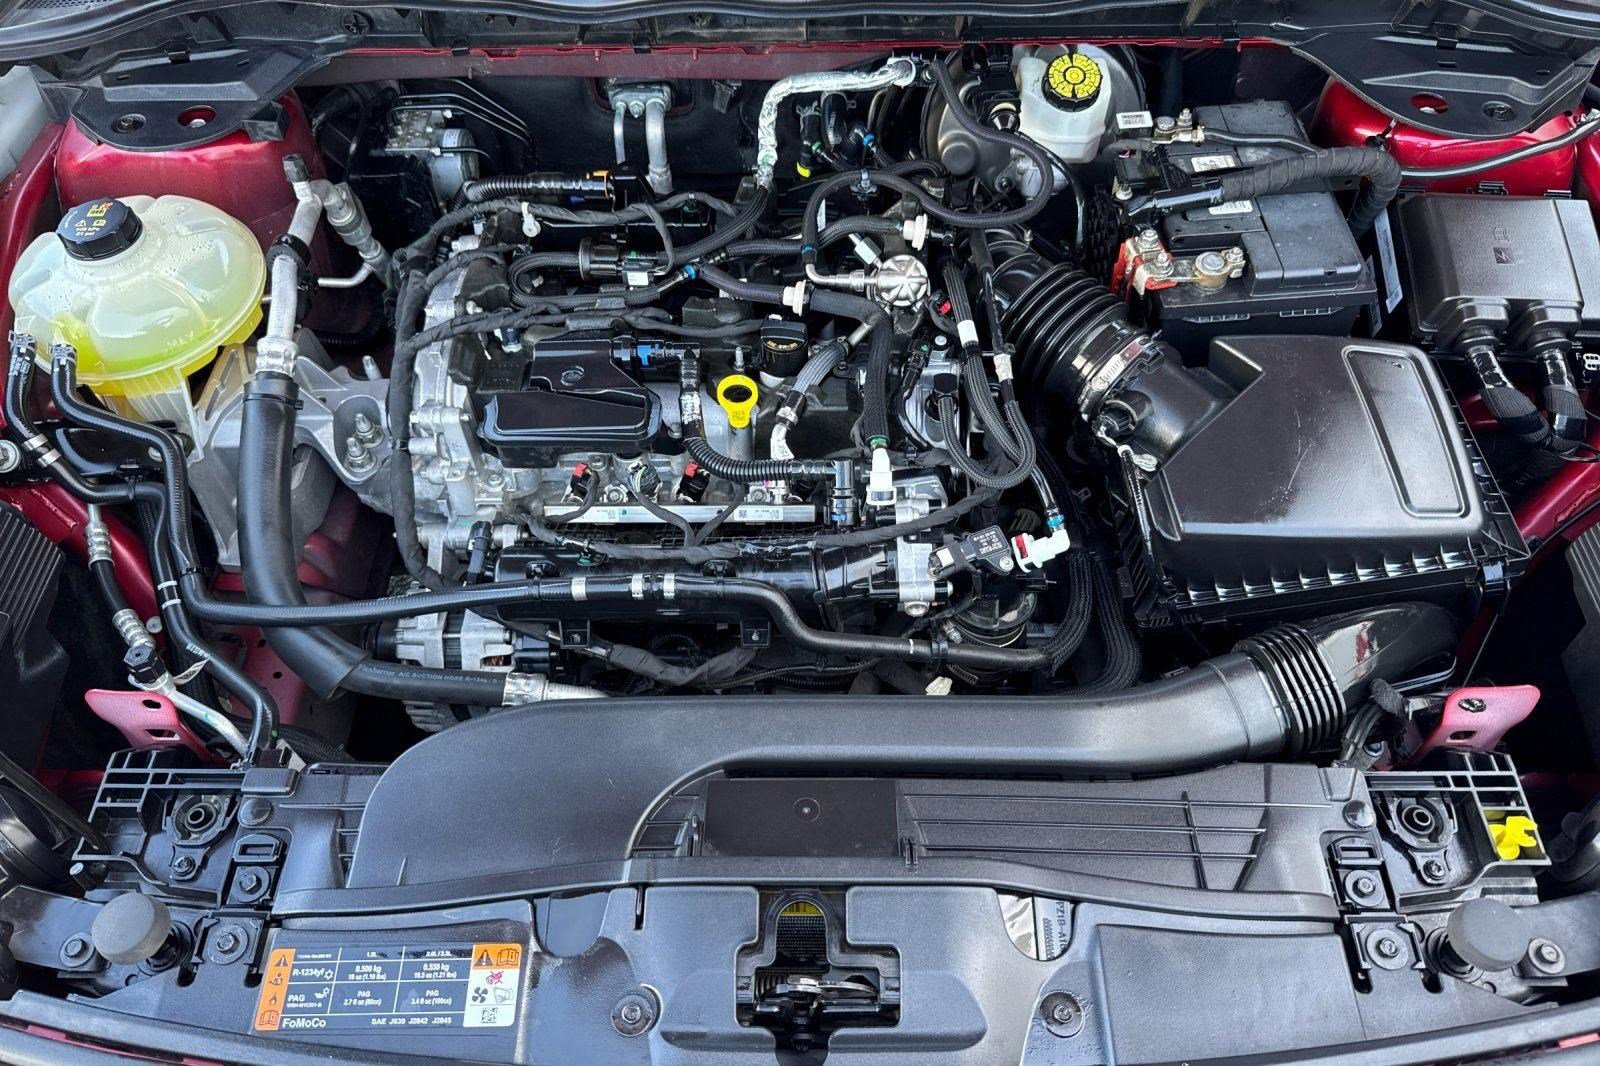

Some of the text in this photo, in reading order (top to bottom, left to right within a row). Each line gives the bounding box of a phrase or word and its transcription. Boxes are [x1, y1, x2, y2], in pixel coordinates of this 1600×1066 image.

[412, 672, 443, 680] SUCTION
[373, 964, 382, 973] kg
[441, 963, 450, 972] kg
[292, 968, 325, 978] R-1234yf
[288, 994, 305, 1002] PAG
[282, 1017, 327, 1028] FoMoCo
